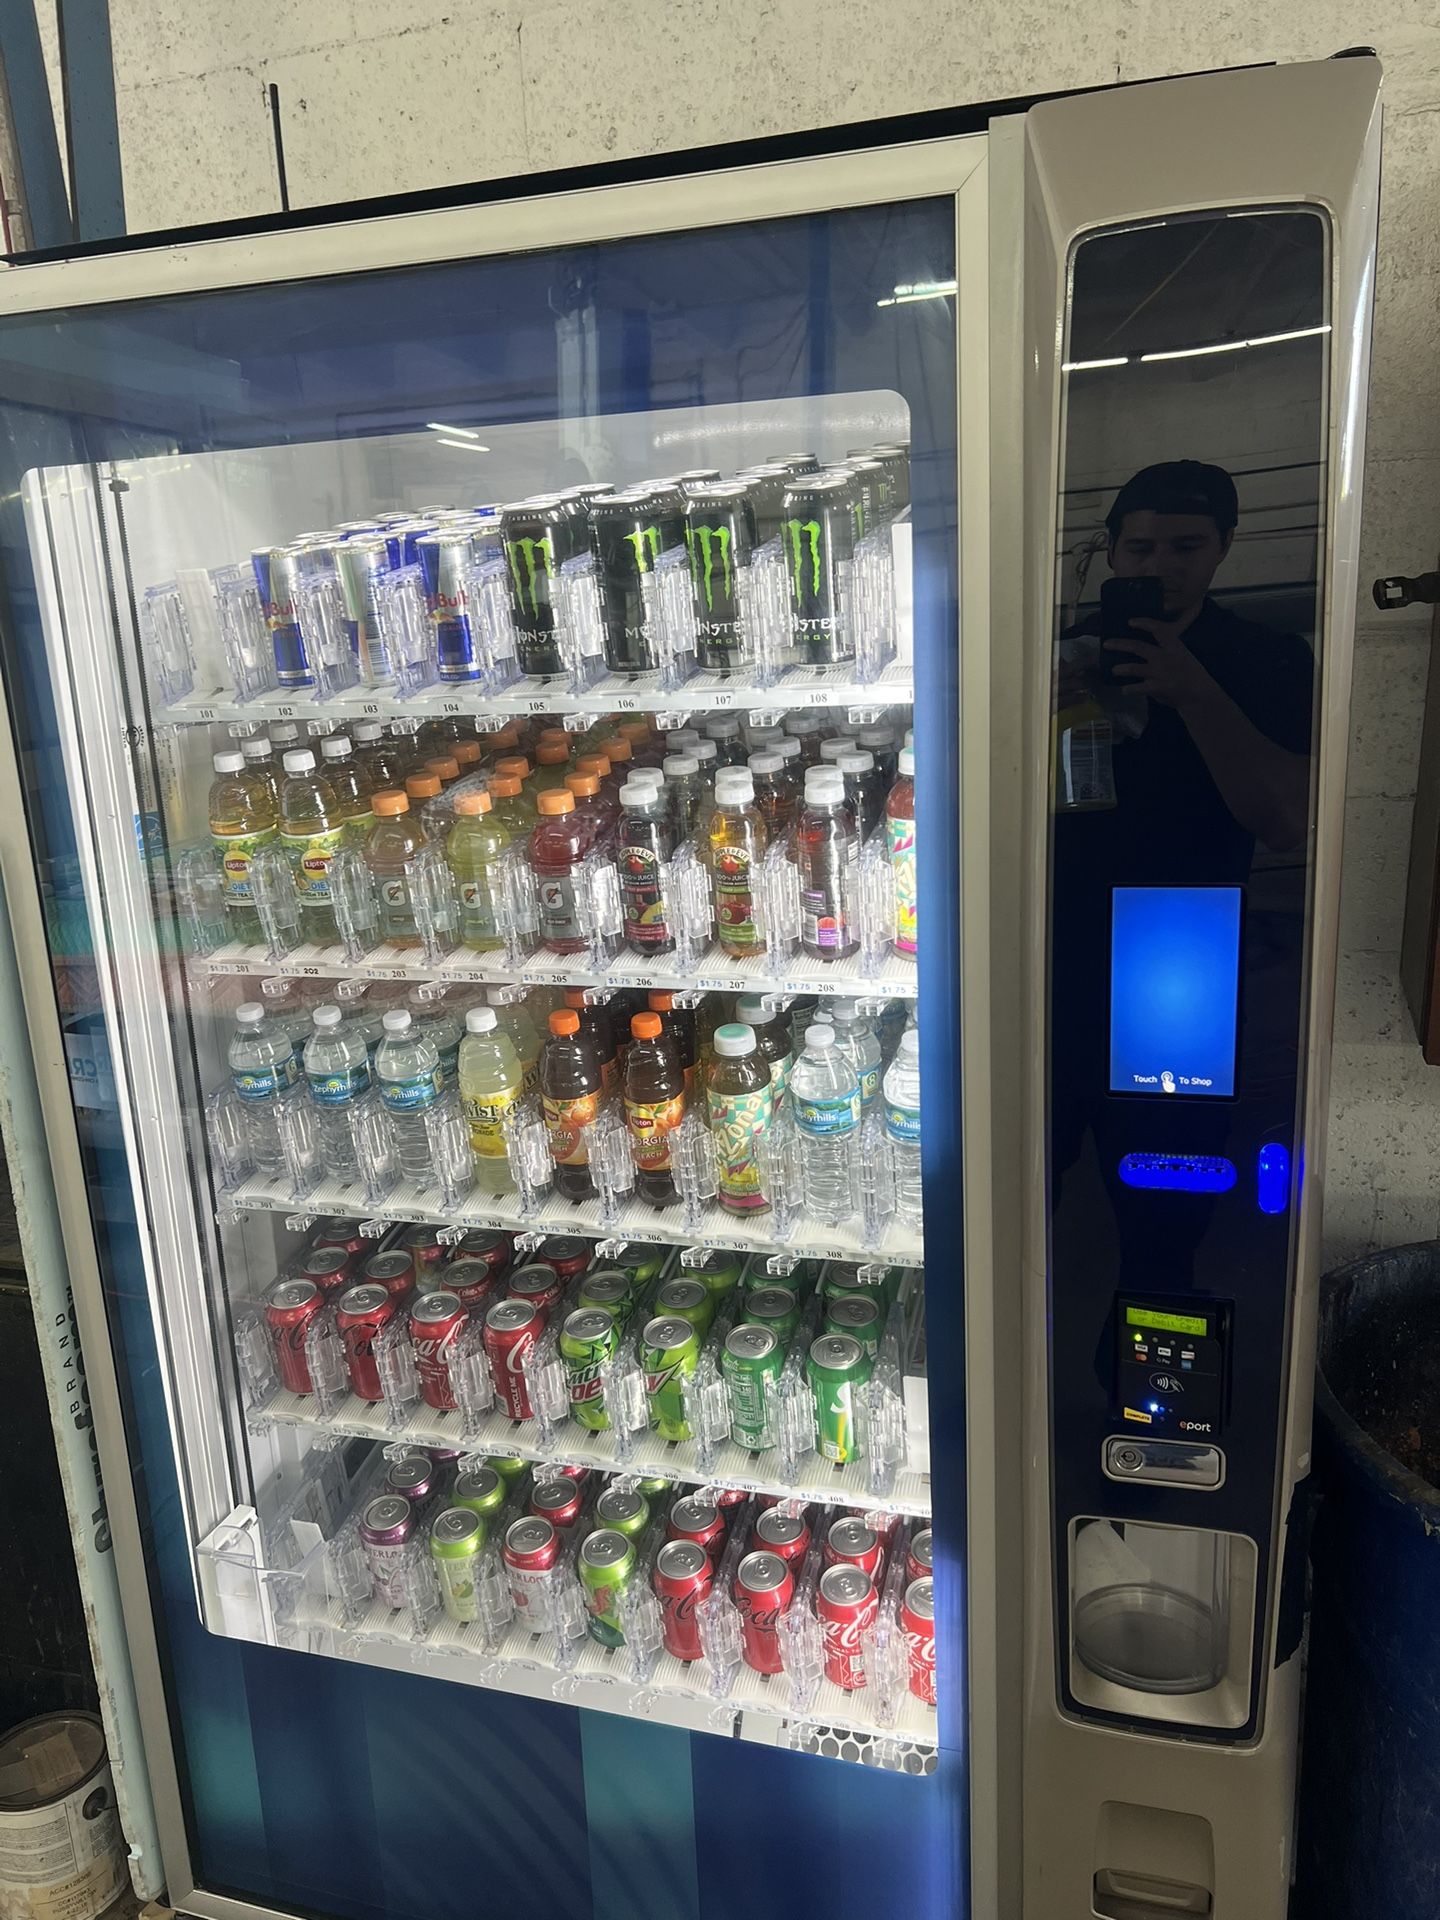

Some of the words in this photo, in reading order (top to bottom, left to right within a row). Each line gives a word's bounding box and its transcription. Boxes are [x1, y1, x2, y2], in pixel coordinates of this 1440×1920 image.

[714, 695, 732, 705] 107
[809, 692, 828, 703] 108
[363, 704, 378, 714] 103
[443, 703, 459, 712] 104
[528, 701, 545, 711] 105
[617, 699, 635, 710] 106
[278, 707, 293, 716] 102
[304, 967, 319, 975] 202
[392, 970, 407, 978] 203
[468, 972, 484, 981] 204
[551, 974, 567, 983] 205
[636, 977, 652, 986] 206
[729, 980, 745, 989] 207
[817, 983, 835, 992] 208
[1133, 1075, 1158, 1083] Touch
[1178, 1076, 1190, 1085] To
[1191, 1077, 1213, 1087] Shop
[332, 1207, 346, 1216] 302
[410, 1213, 425, 1222] 303
[487, 1219, 502, 1228] 304
[566, 1226, 582, 1235] 305
[646, 1234, 663, 1243] 306
[732, 1241, 749, 1251] 307
[825, 1251, 843, 1260] 308
[1180, 1420, 1211, 1432] eport
